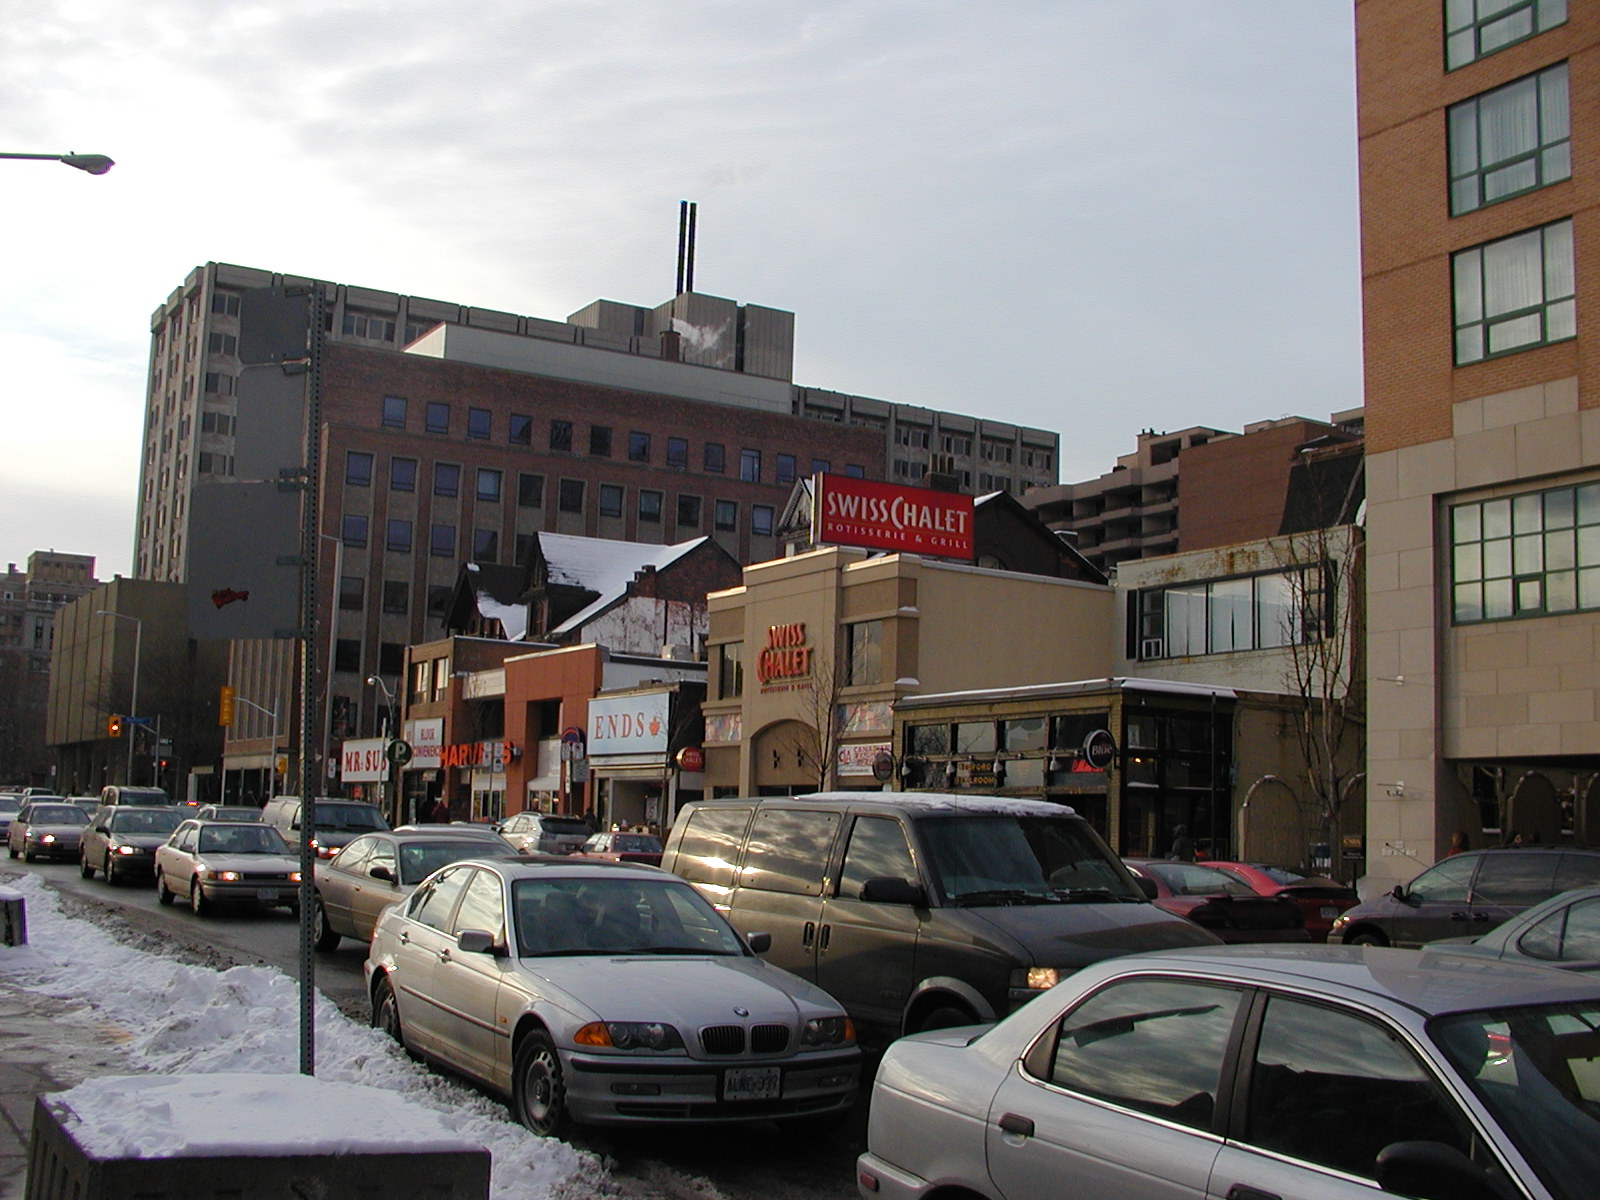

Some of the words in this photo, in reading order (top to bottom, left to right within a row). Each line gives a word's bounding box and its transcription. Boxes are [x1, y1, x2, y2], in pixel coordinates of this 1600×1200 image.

[827, 522, 905, 541] ROTISSERIE
[915, 534, 923, 543] &
[931, 536, 968, 549] GRILL
[766, 622, 806, 649] SWISS
[755, 647, 813, 684] CHALET
[594, 712, 645, 740] ENDS
[395, 742, 406, 759] P
